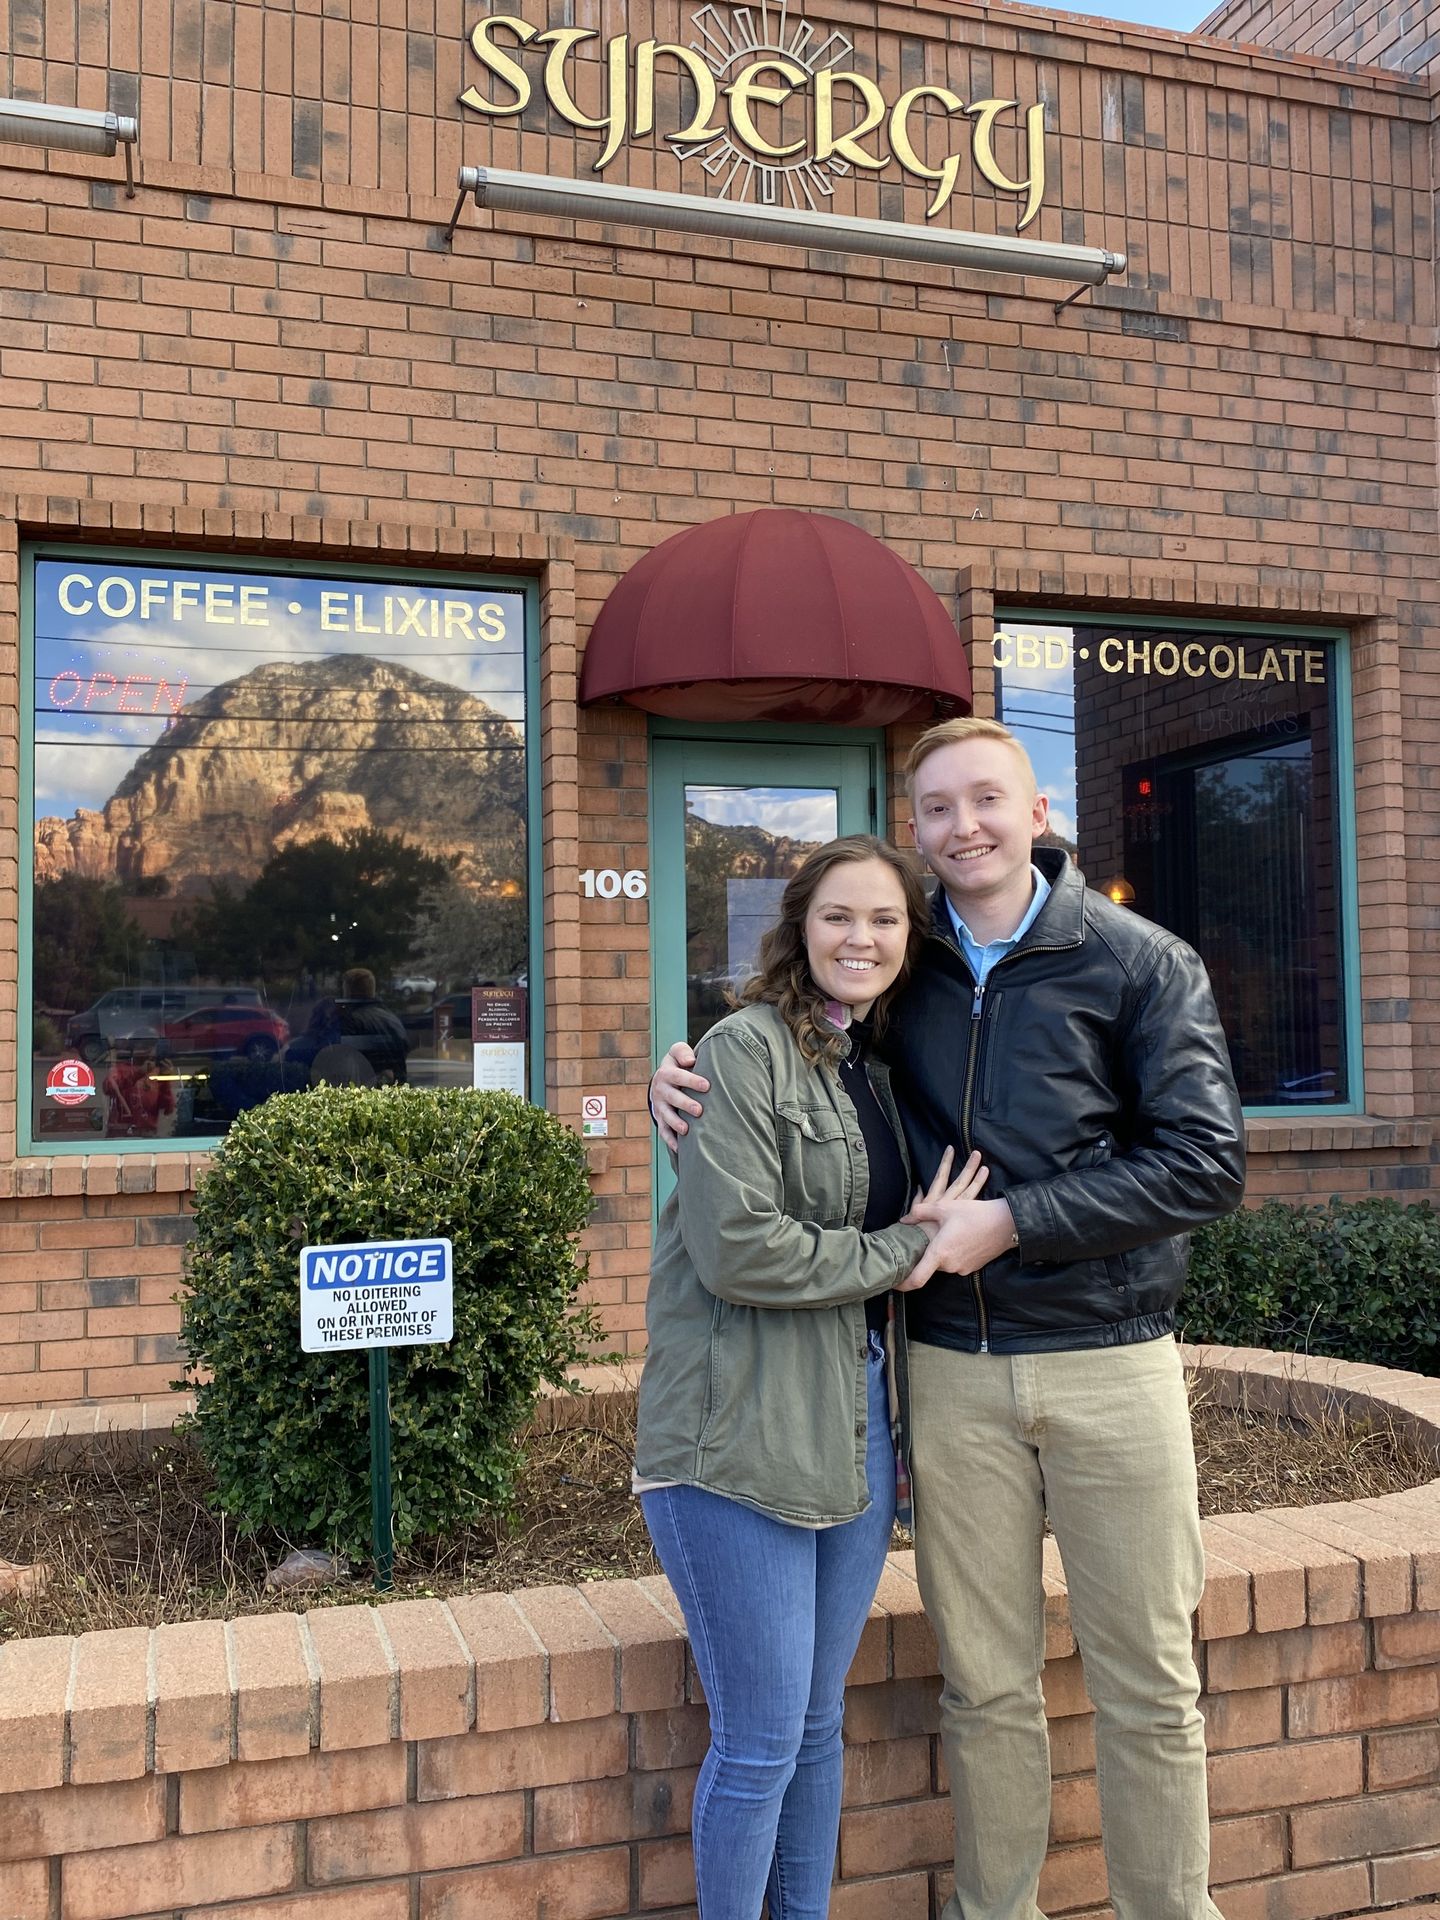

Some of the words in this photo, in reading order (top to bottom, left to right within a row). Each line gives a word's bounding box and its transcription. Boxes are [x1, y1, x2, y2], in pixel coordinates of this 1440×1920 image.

[457, 14, 1046, 231] SYNERGY
[57, 573, 270, 628] COFFEE
[320, 591, 507, 643] ELIXIRS
[990, 631, 1070, 670] CBD
[1099, 637, 1326, 684] CHOCOLATE
[50, 670, 188, 713] OPEN
[1198, 708, 1298, 734] DRINKS
[578, 869, 648, 899] 106
[312, 1249, 442, 1285] NOTICE
[333, 1290, 351, 1303] NO
[355, 1285, 421, 1301] LOITERING
[346, 1299, 407, 1315] ALLOWED
[317, 1317, 335, 1330] ON
[339, 1315, 357, 1328] OR
[361, 1314, 374, 1327] IN
[377, 1311, 418, 1325] FRONT
[421, 1310, 438, 1322] OF
[322, 1328, 363, 1342] THESE
[366, 1323, 432, 1339] PREMISES
